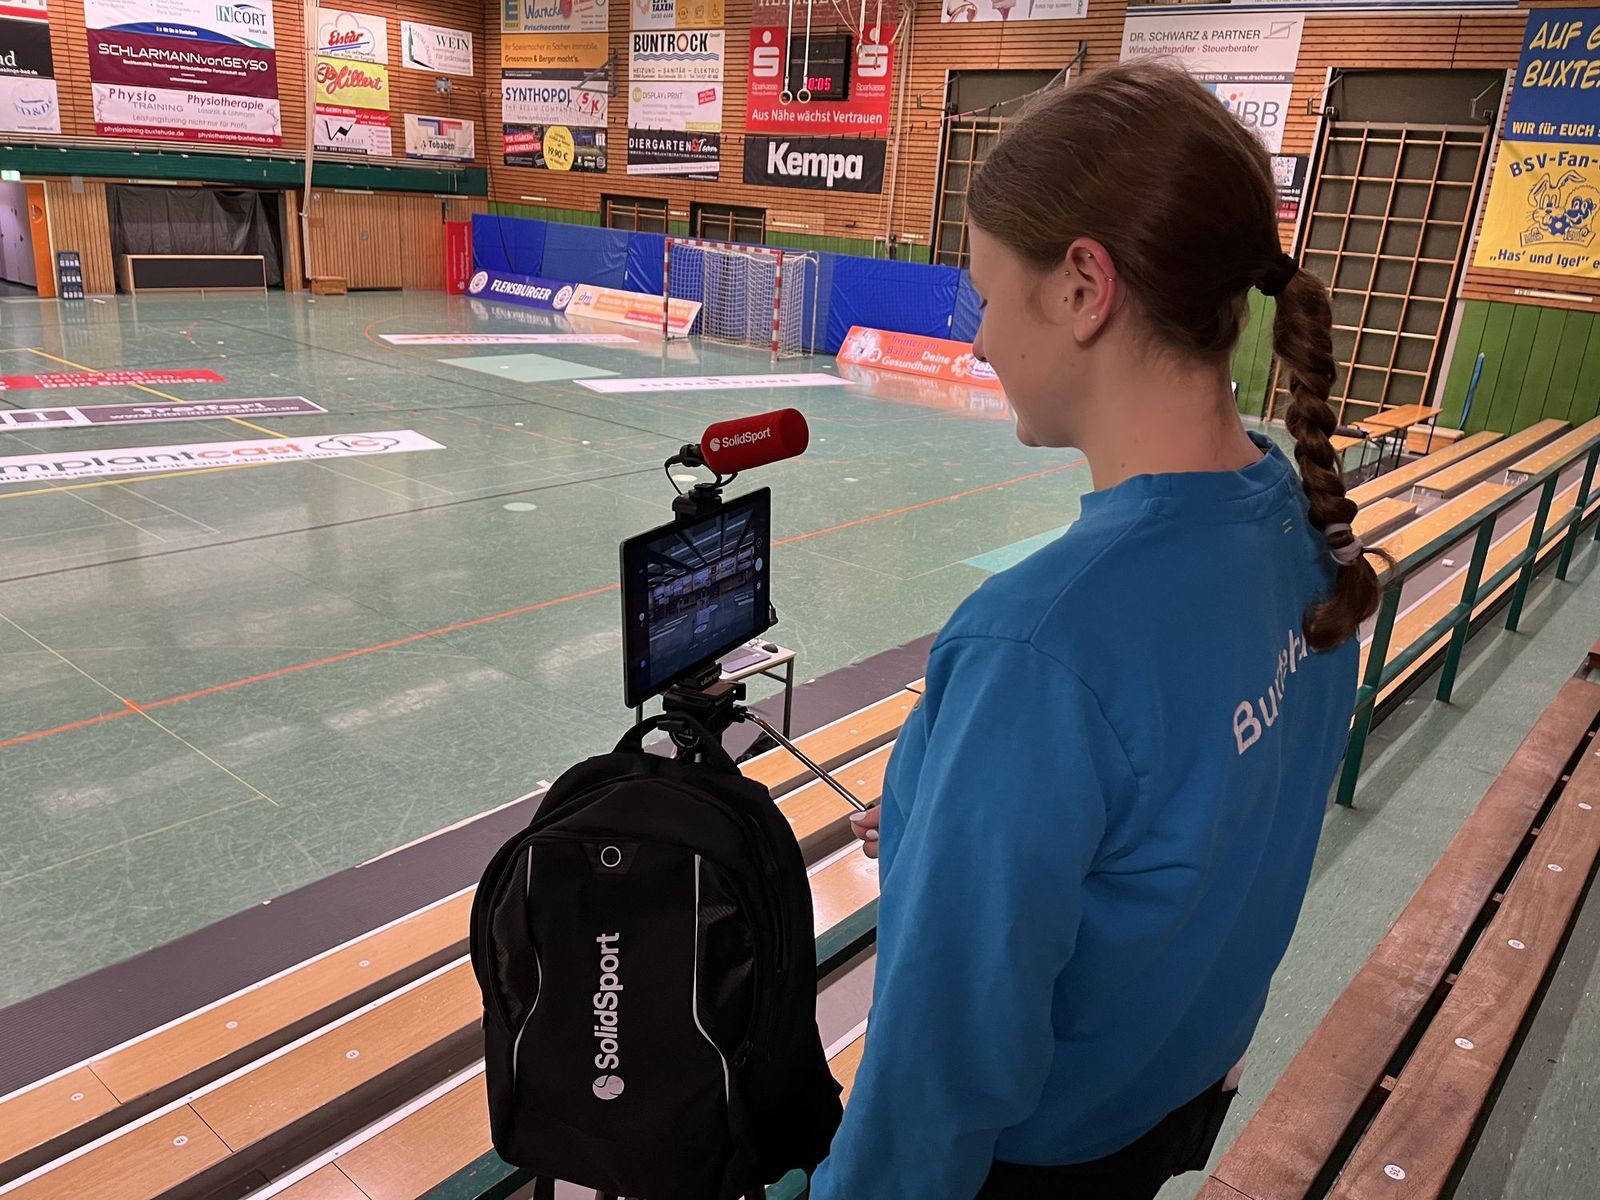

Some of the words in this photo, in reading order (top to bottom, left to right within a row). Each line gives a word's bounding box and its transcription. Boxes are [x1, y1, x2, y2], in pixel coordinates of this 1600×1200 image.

[216, 5, 266, 26] INCORT
[652, 3, 674, 12] TAXEN
[436, 34, 470, 51] WEIN
[633, 33, 708, 53] BUNTROCK
[1130, 33, 1146, 42] DR.
[1149, 31, 1199, 42] SCHWARZ
[1201, 32, 1208, 40] &
[1211, 30, 1261, 40] PARTNER
[1529, 21, 1583, 50] AUF
[98, 42, 268, 72] SCHLARMANNvonGEYSO
[1128, 46, 1196, 55] Wirtschaftsprüfer
[1201, 44, 1259, 53] Steuerberater
[1522, 59, 1600, 89] BUXTE
[109, 87, 157, 103] Physio
[187, 94, 264, 111] Physiotherapie
[505, 87, 572, 103] SYNTHOPOL
[132, 101, 184, 113] TRAINING
[752, 109, 769, 121] Aus
[771, 108, 796, 122] Nähe
[797, 110, 831, 123] wächst
[832, 110, 883, 124] Vertrauen
[1512, 121, 1536, 134] WIR
[1538, 122, 1557, 135] für
[1559, 123, 1595, 137] EUCH
[428, 140, 455, 150] Tobaben
[767, 142, 864, 187] Kempa
[1509, 151, 1600, 178] BSV-Fan-
[1529, 253, 1553, 264] und
[490, 279, 552, 301] FLENSBURGER
[881, 355, 941, 373] Gesundheit!
[921, 351, 951, 365] Deine
[722, 426, 771, 448] SolidSport
[593, 932, 623, 1069] SolidSport
